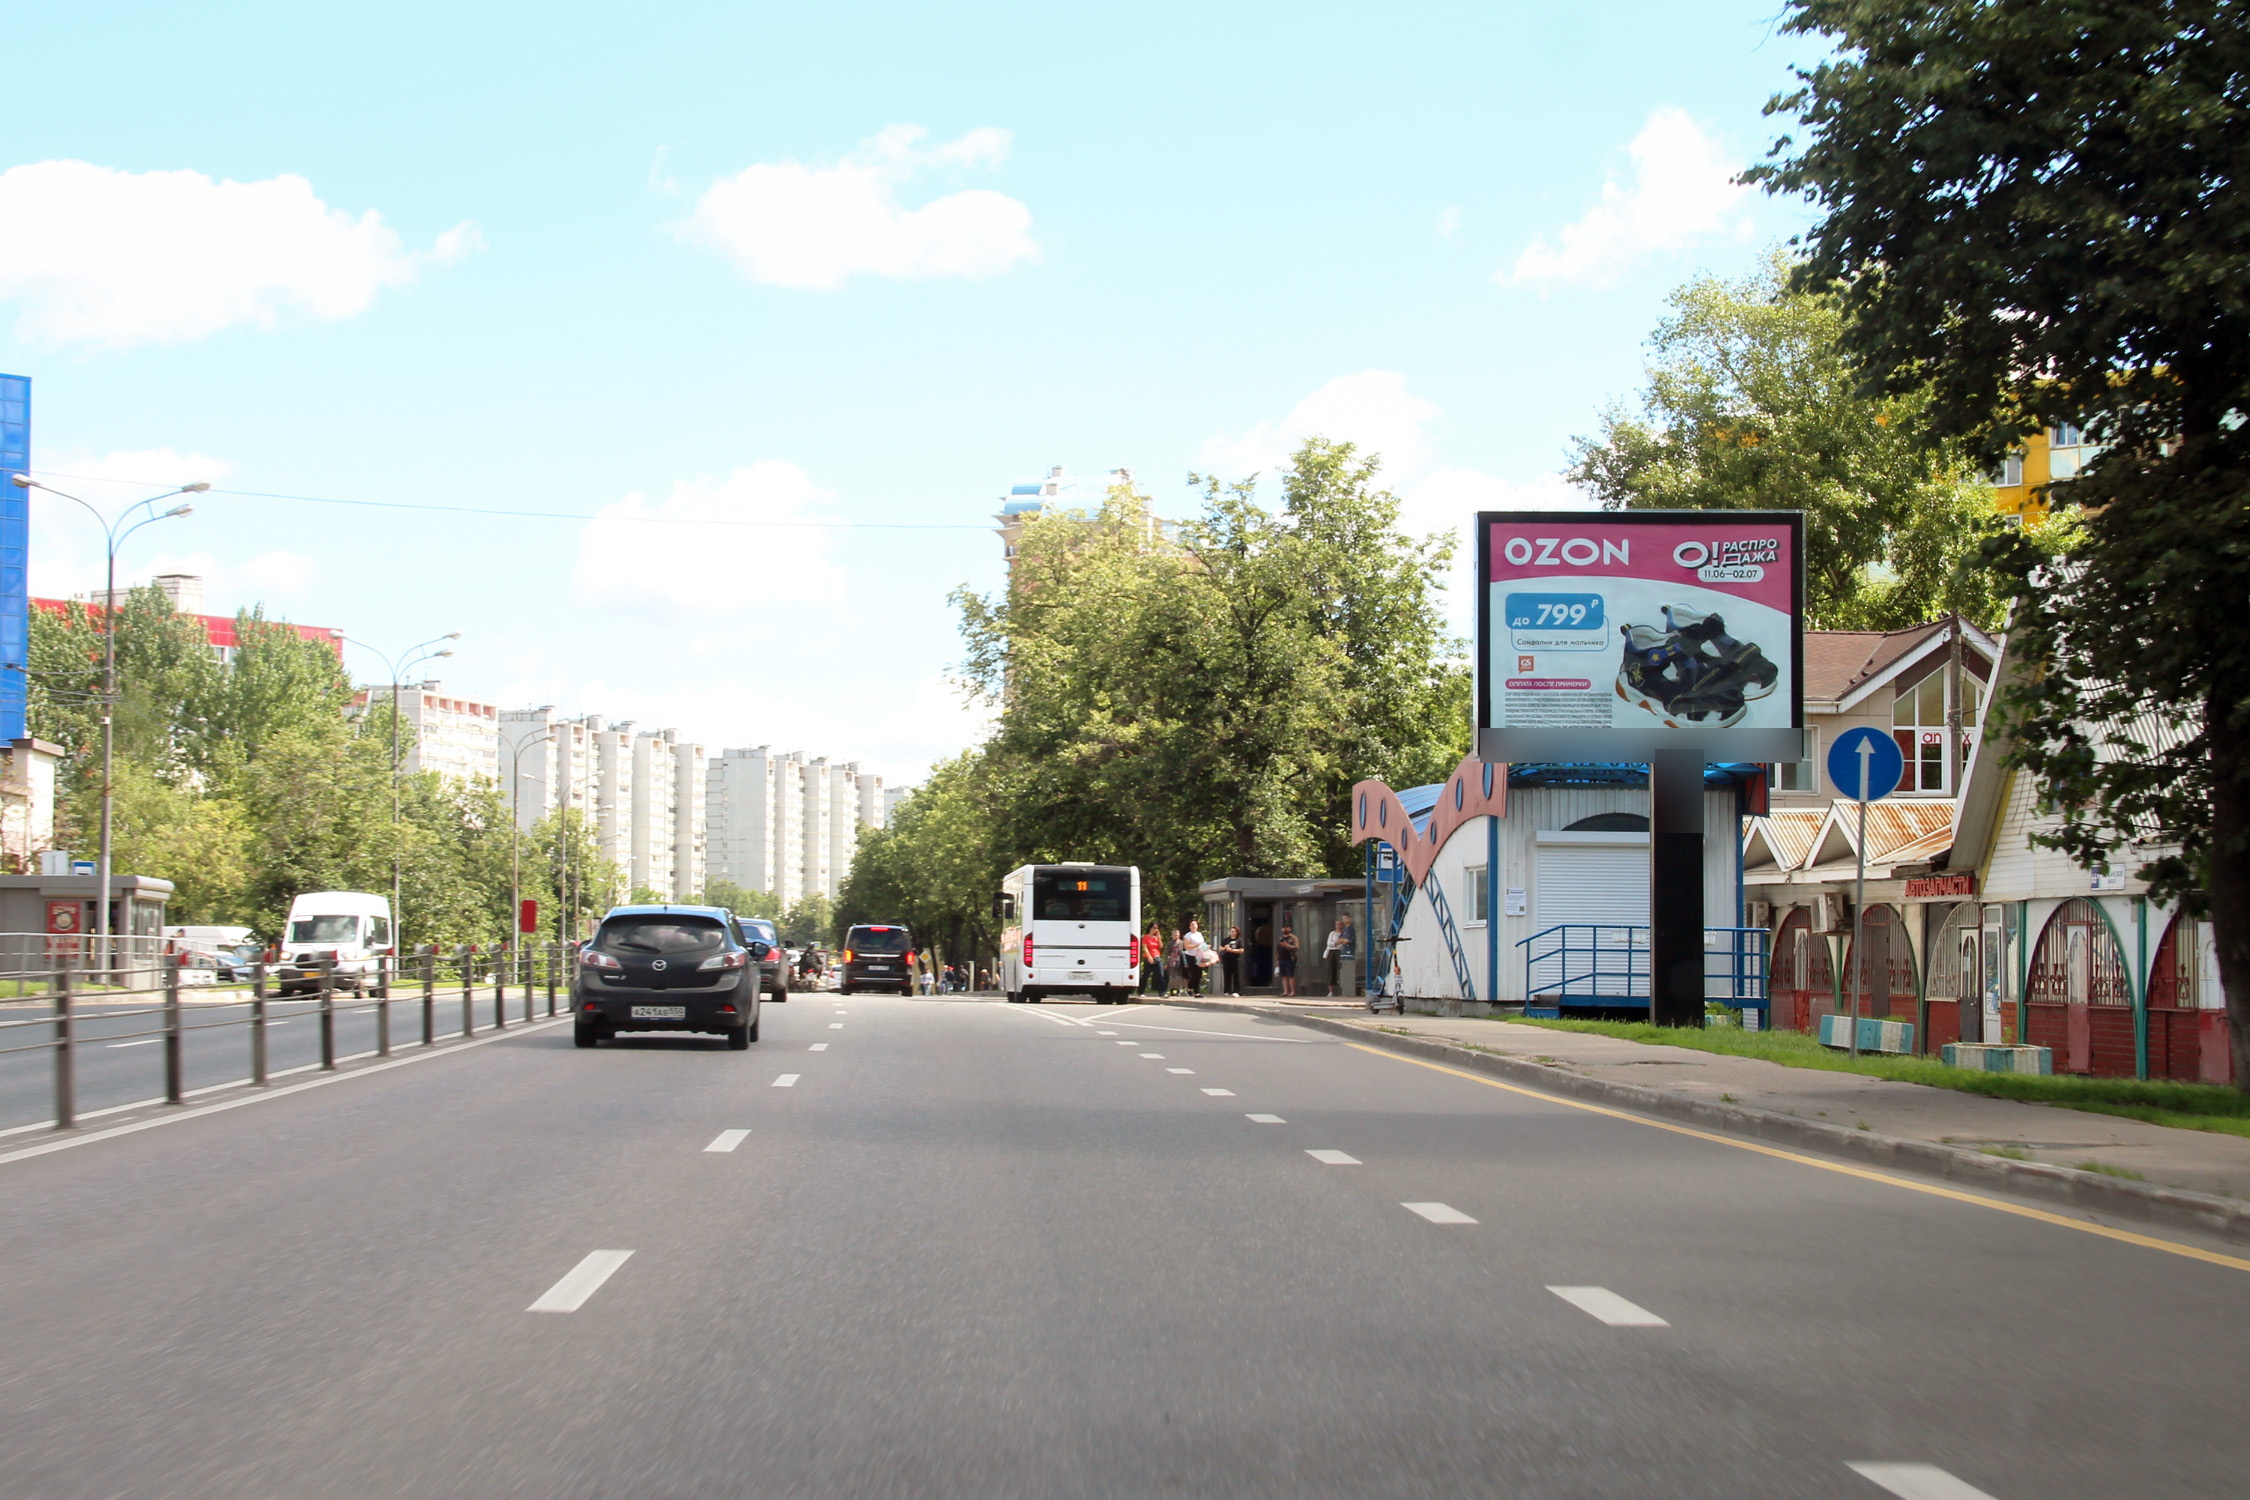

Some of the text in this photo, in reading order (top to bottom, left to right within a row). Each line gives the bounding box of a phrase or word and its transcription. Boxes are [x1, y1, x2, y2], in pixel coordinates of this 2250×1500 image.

[1504, 537, 1629, 566] OZON
[1722, 539, 1778, 552] РАСПРО
[1720, 551, 1777, 568] ДАЖА
[1512, 617, 1530, 627] до
[1536, 603, 1587, 625] 799
[1516, 638, 1553, 646] Сандалии
[1076, 881, 1088, 891] 11
[1905, 876, 1969, 897] АВТОЗАПЧАСТИ
